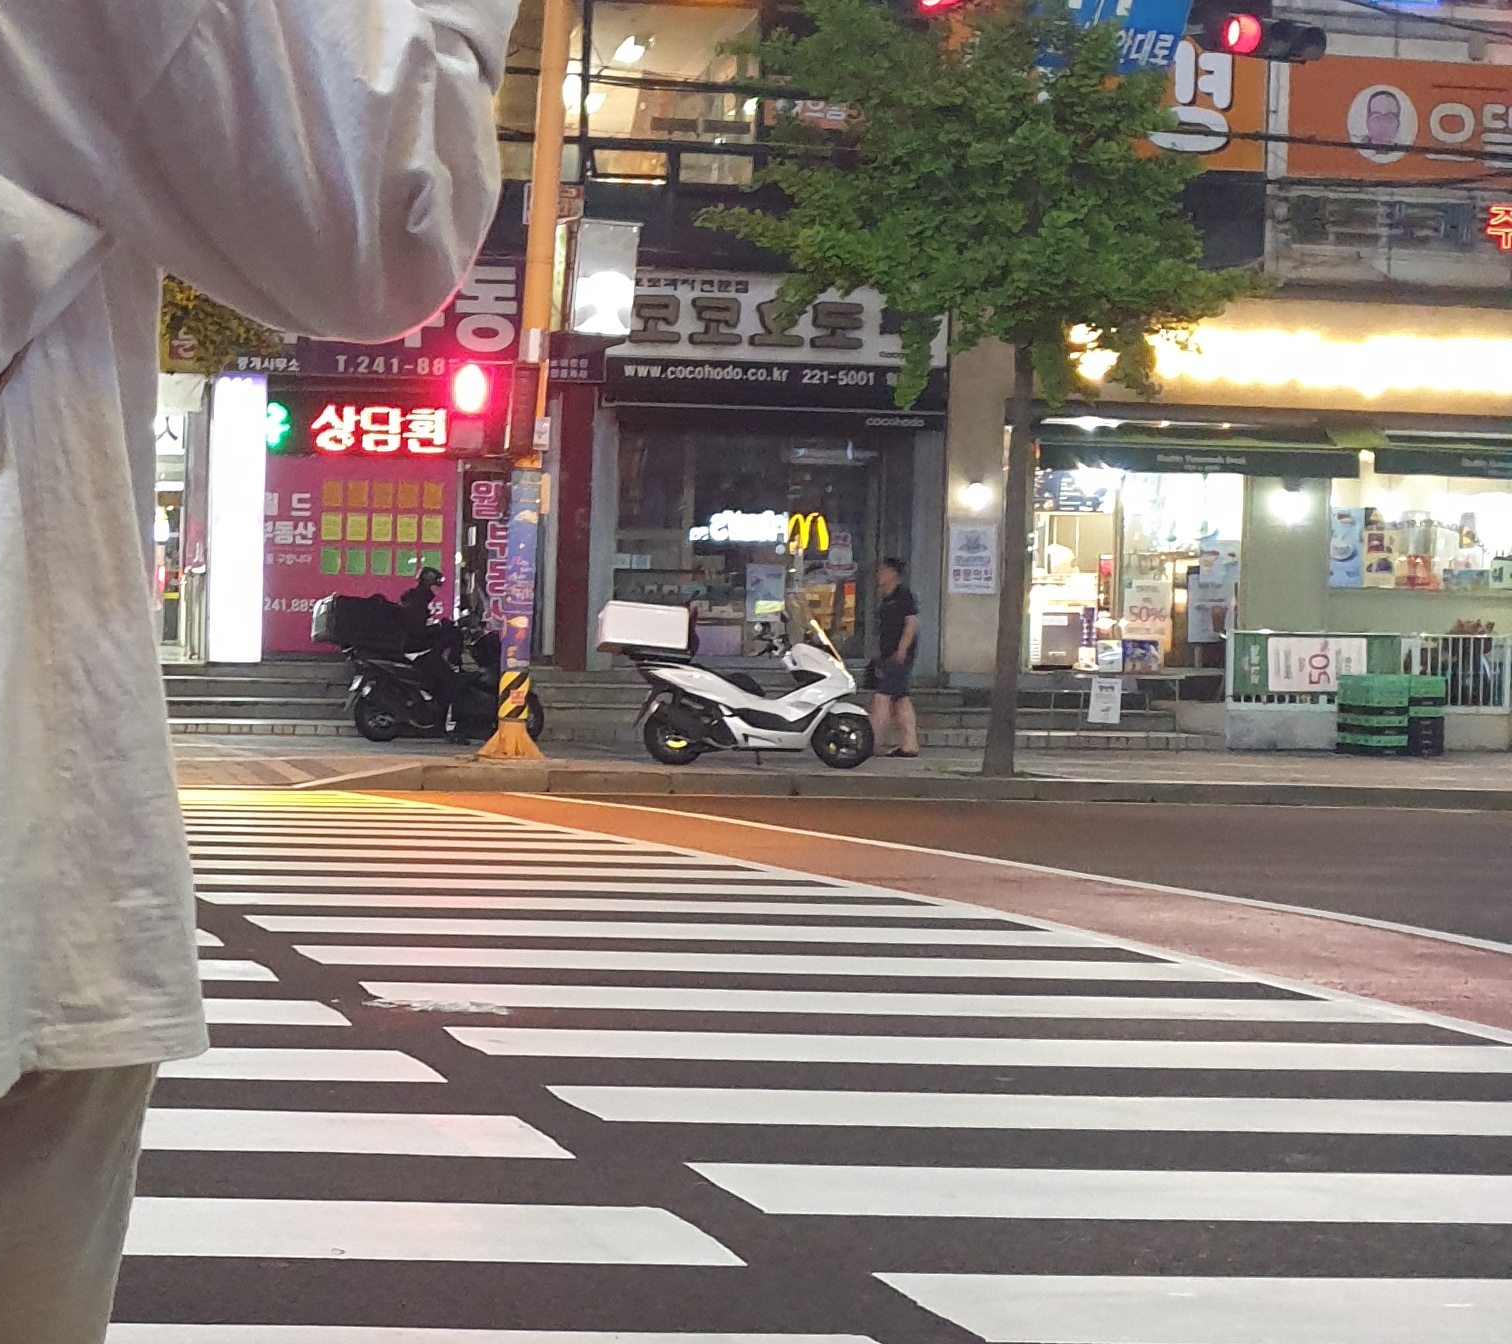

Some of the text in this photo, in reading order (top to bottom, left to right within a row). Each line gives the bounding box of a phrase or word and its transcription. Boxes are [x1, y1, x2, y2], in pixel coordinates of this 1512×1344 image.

[335, 354, 446, 376] T.241-88
[624, 363, 789, 384] www.cocohodo.co.kr
[802, 369, 875, 387] 221-5001
